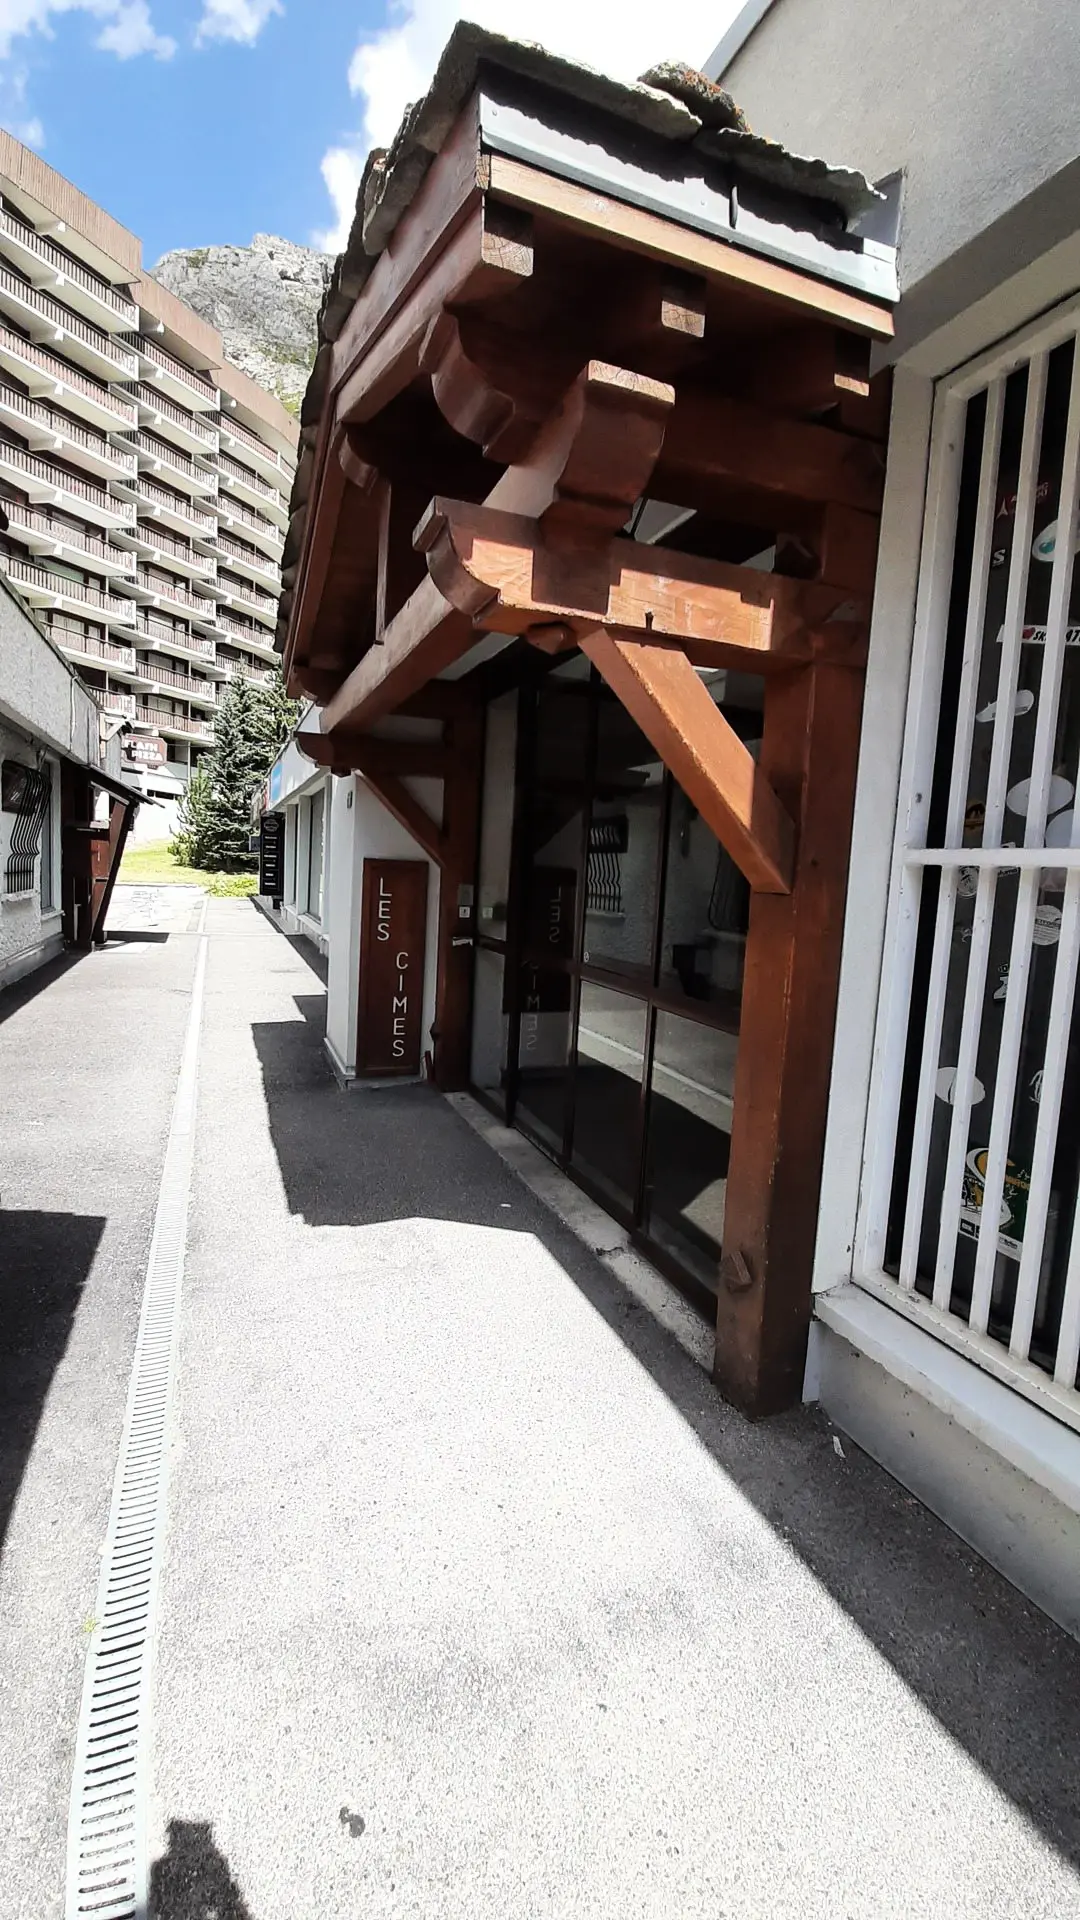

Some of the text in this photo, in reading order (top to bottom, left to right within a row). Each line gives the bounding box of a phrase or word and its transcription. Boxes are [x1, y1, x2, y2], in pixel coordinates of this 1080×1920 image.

[131, 750, 164, 761] PIZZA
[376, 877, 393, 941] LES
[391, 951, 409, 1057] CIMES
